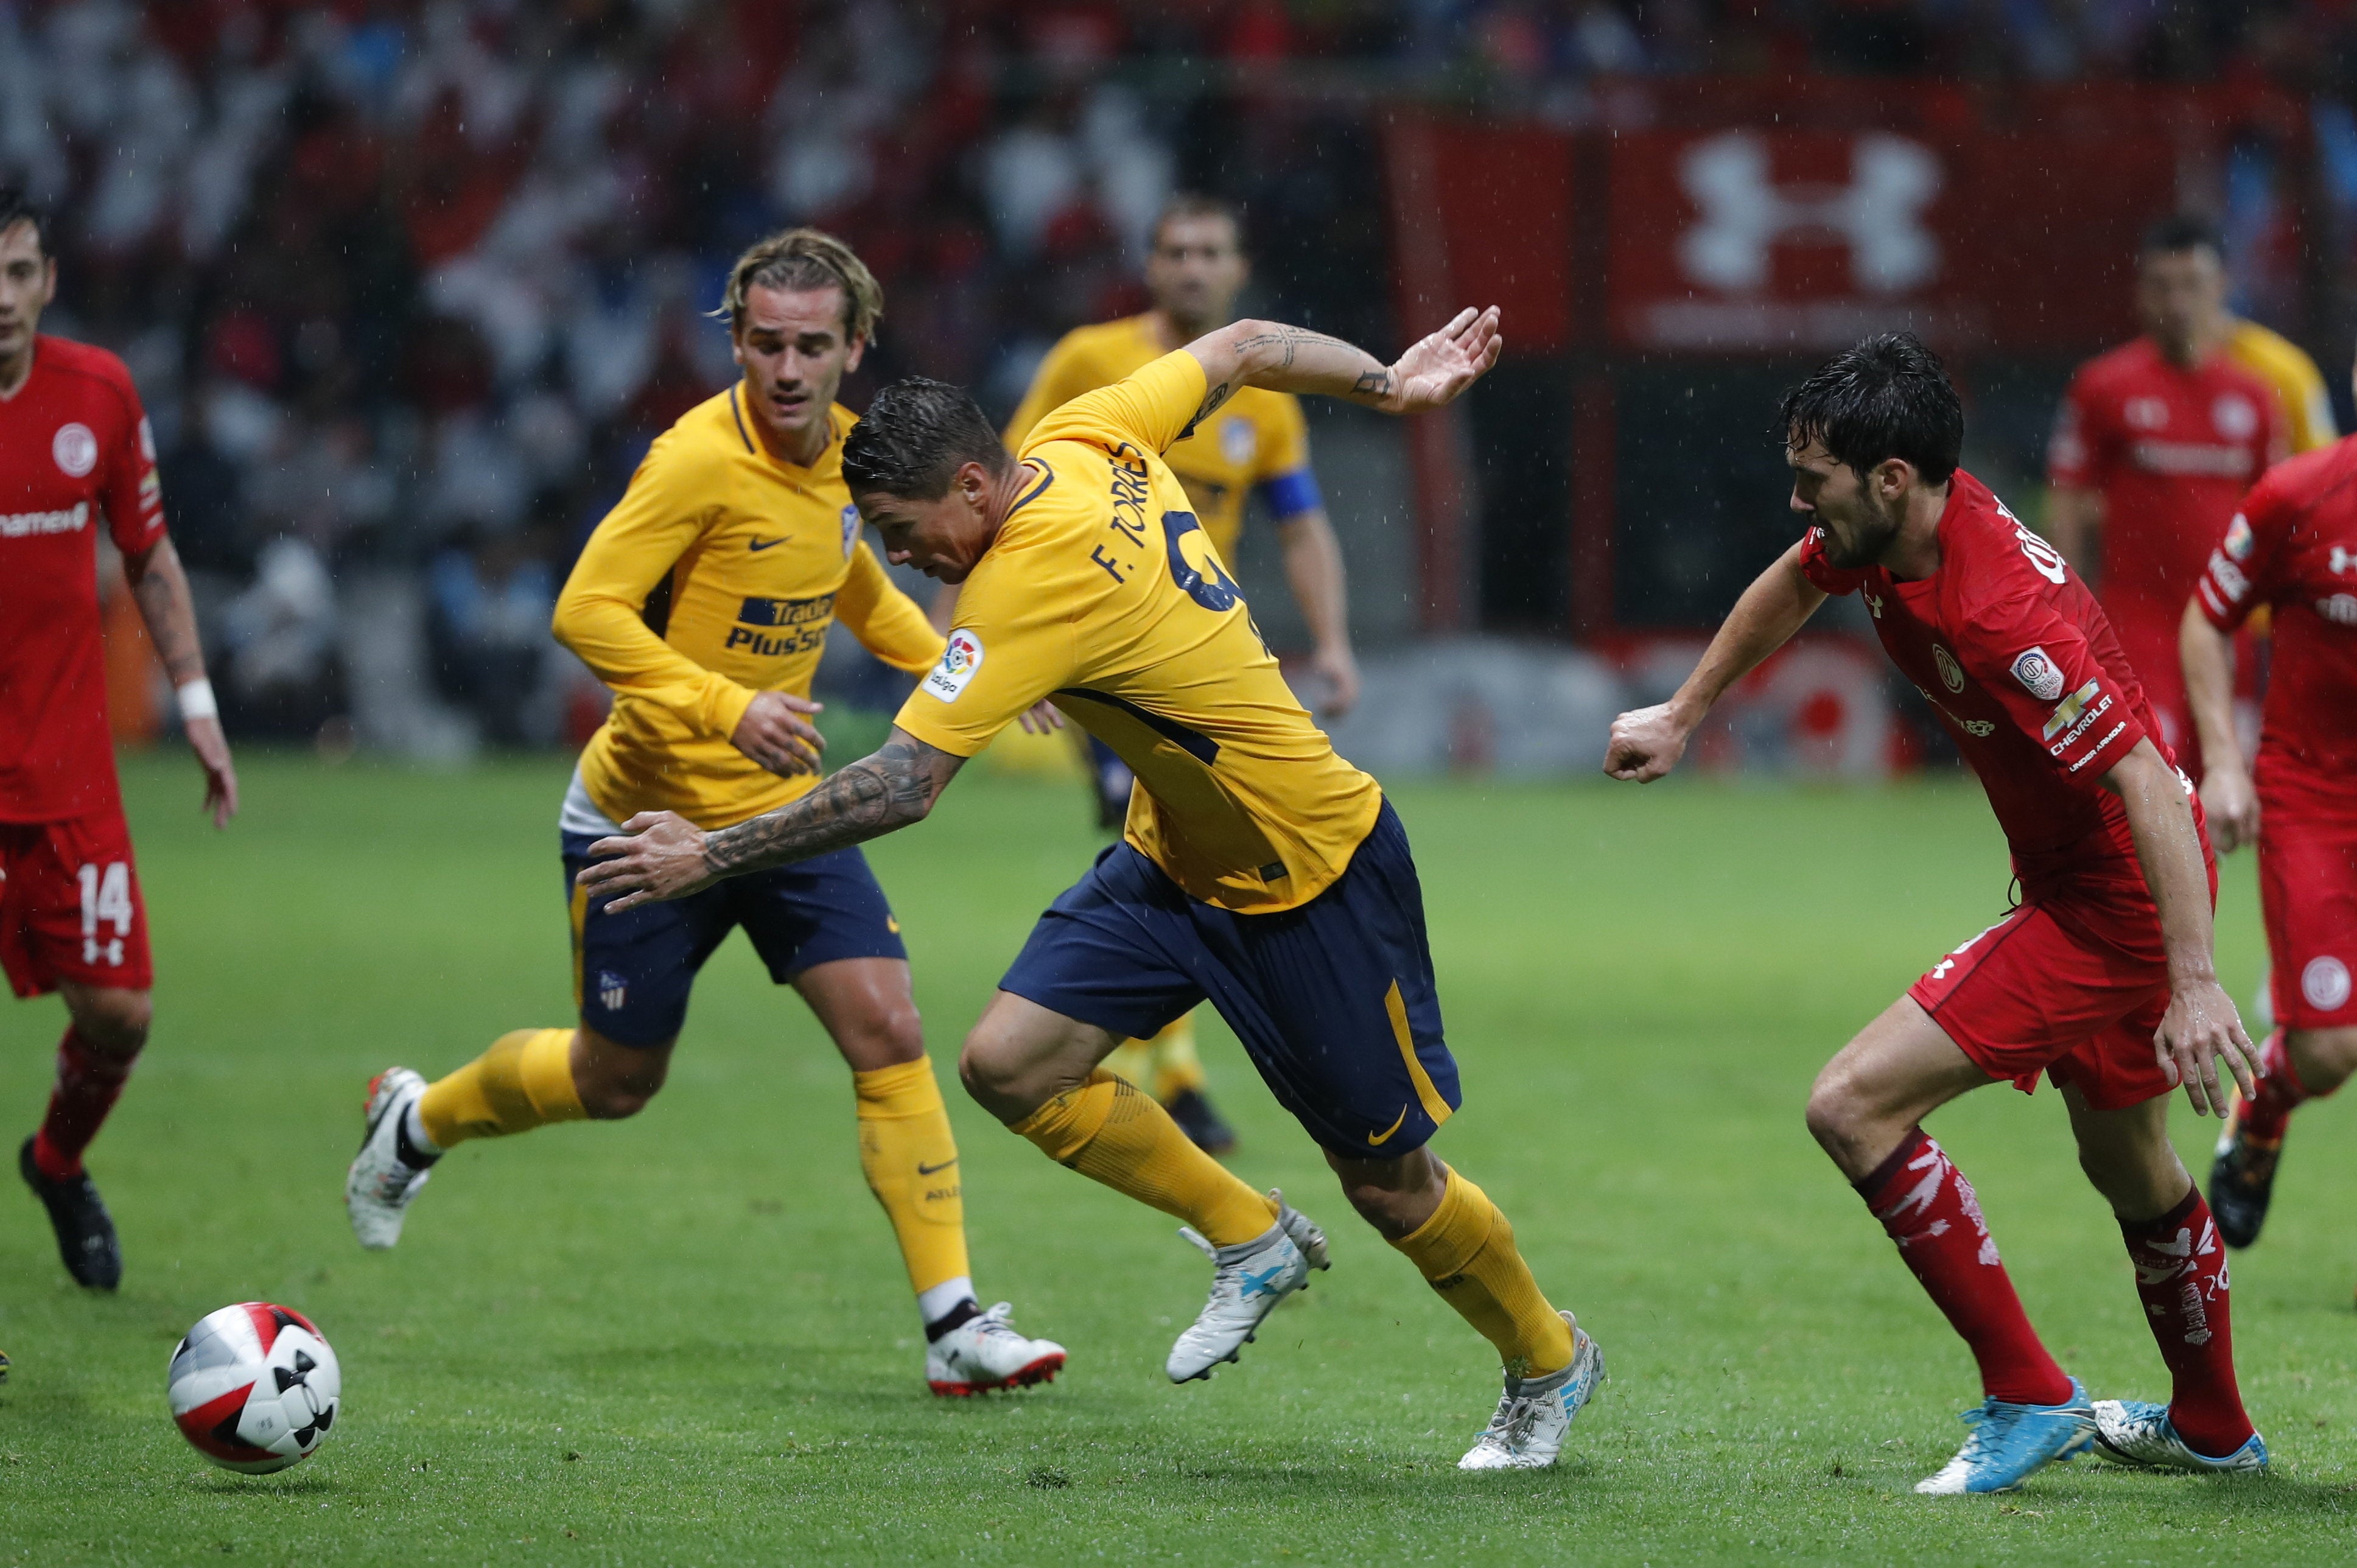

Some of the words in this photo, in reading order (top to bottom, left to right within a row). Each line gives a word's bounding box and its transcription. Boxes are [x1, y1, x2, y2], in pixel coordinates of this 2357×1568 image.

[1103, 441, 1149, 548] TORRES
[1090, 544, 1135, 584] F.
[2050, 694, 2113, 756] CHEVROLET
[2069, 749, 2097, 772] UNDER
[2096, 721, 2127, 752] ARMOUR
[76, 861, 134, 937] 14
